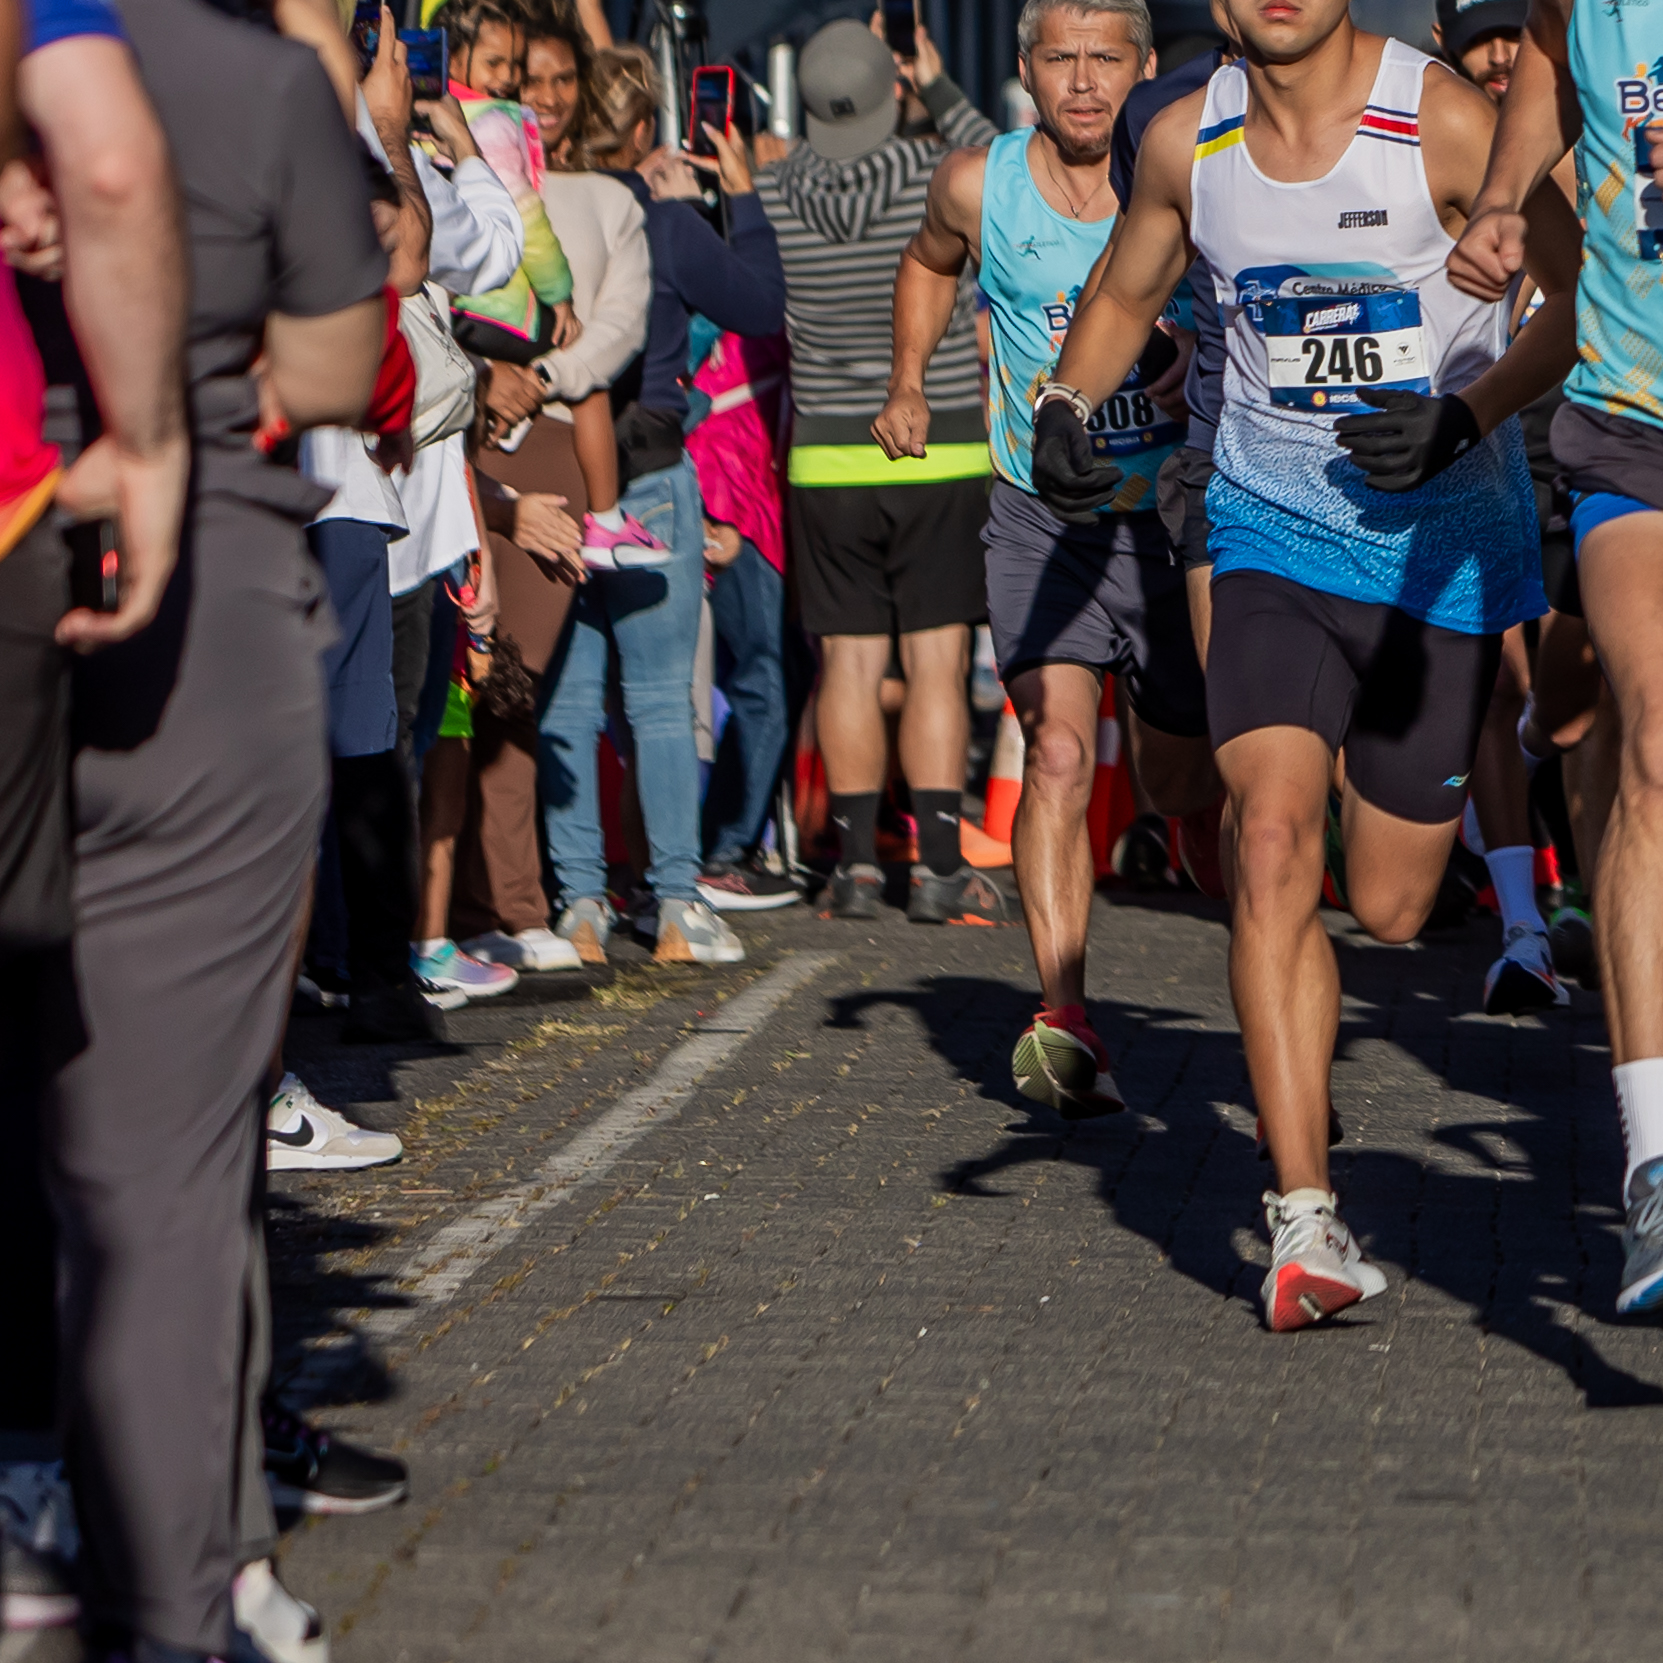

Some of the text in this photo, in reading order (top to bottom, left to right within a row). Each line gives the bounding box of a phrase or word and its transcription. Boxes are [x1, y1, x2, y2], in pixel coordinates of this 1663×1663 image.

[1337, 209, 1389, 229] JEFFERSON
[1304, 302, 1358, 330] CARRERA
[1301, 336, 1384, 384] 246
